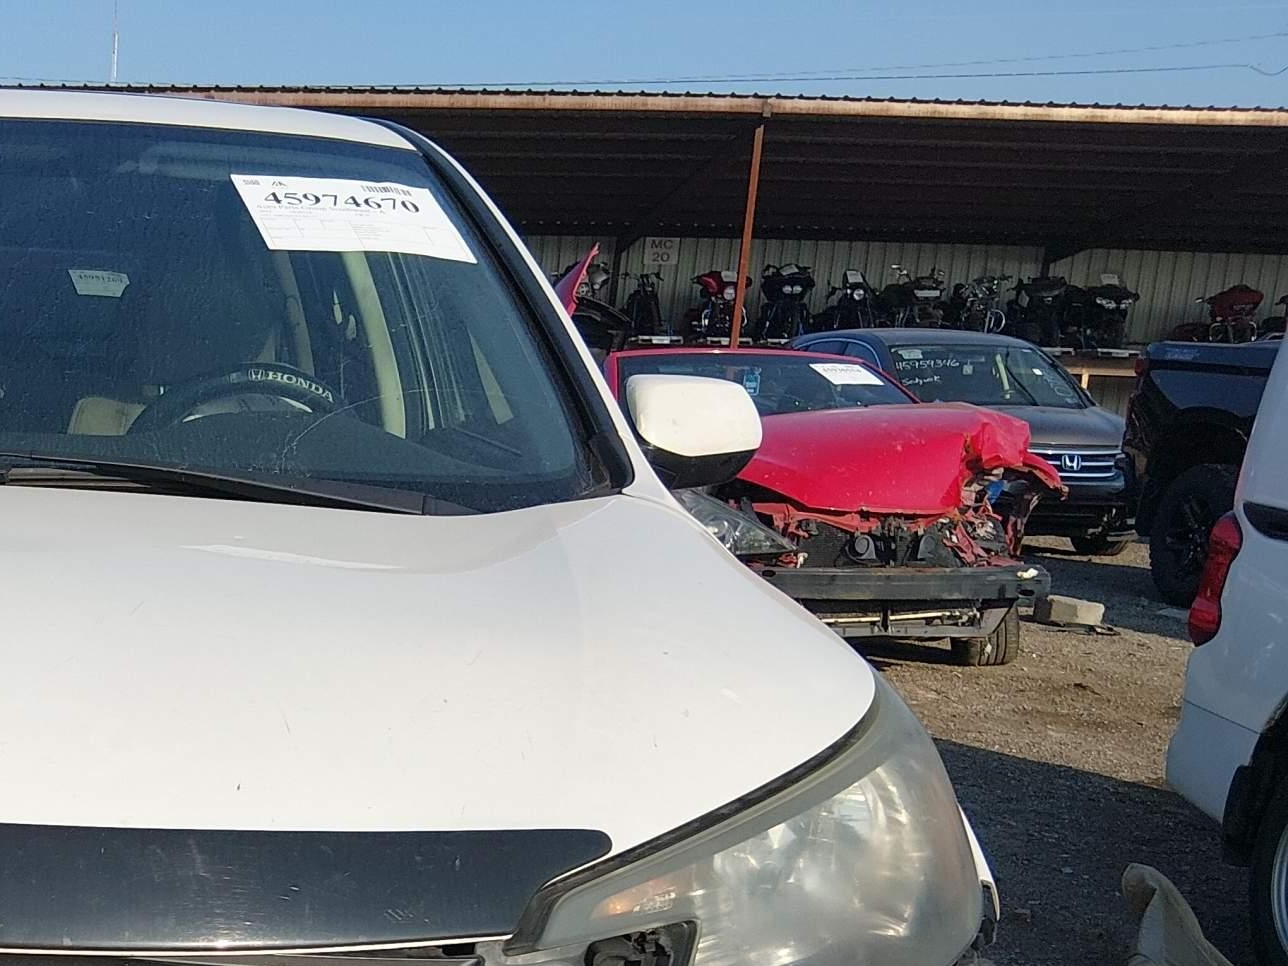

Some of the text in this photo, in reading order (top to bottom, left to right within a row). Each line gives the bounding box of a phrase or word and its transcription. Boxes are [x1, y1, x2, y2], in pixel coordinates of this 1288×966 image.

[264, 191, 420, 214] 45974670
[650, 240, 673, 249] MC
[652, 252, 671, 263] 20
[267, 371, 334, 404] HONDA
